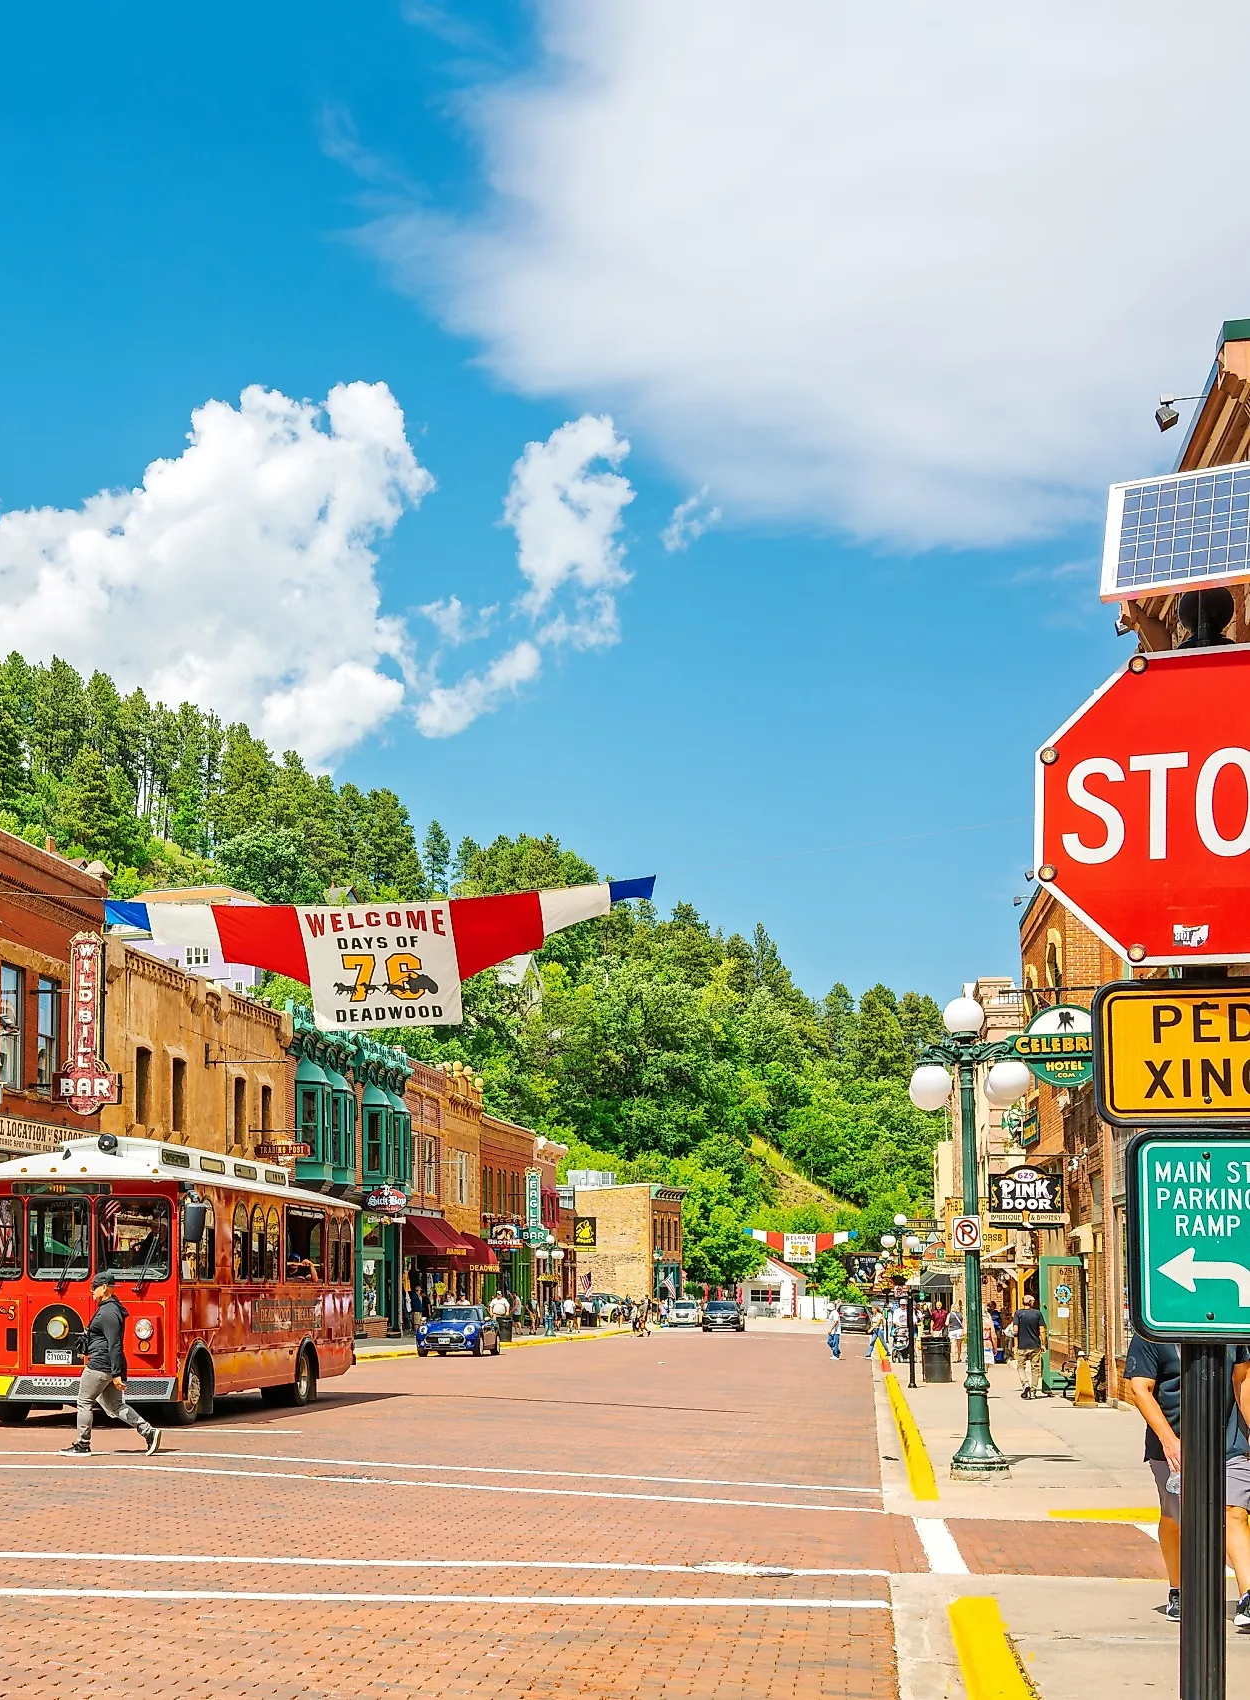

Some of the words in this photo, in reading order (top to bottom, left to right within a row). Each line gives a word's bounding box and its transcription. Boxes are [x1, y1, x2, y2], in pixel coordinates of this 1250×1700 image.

[305, 909, 446, 938] WELCOME
[336, 936, 388, 949] DAYS
[396, 936, 419, 948] OF
[78, 944, 94, 1000] WILD
[341, 953, 426, 1003] 76
[336, 1005, 443, 1023] DEADWOOD
[1152, 1003, 1250, 1044] PED
[77, 1009, 94, 1070] BILL
[1045, 1060, 1085, 1072] HOTEL
[59, 1077, 111, 1098] BAR
[6, 1119, 47, 1143] LOCATION
[13, 1140, 24, 1149] SPOT
[33, 1143, 42, 1151] THE
[260, 1146, 286, 1154] TRADING
[288, 1145, 304, 1153] POST
[1155, 1161, 1211, 1184] MAIN
[999, 1179, 1052, 1199] PINK
[529, 1180, 538, 1227] EAGLE
[1002, 1198, 1052, 1210] DOOR
[1175, 1214, 1241, 1237] RAMP
[982, 1233, 1002, 1241] ORSE
[8, 1305, 16, 1320] 5
